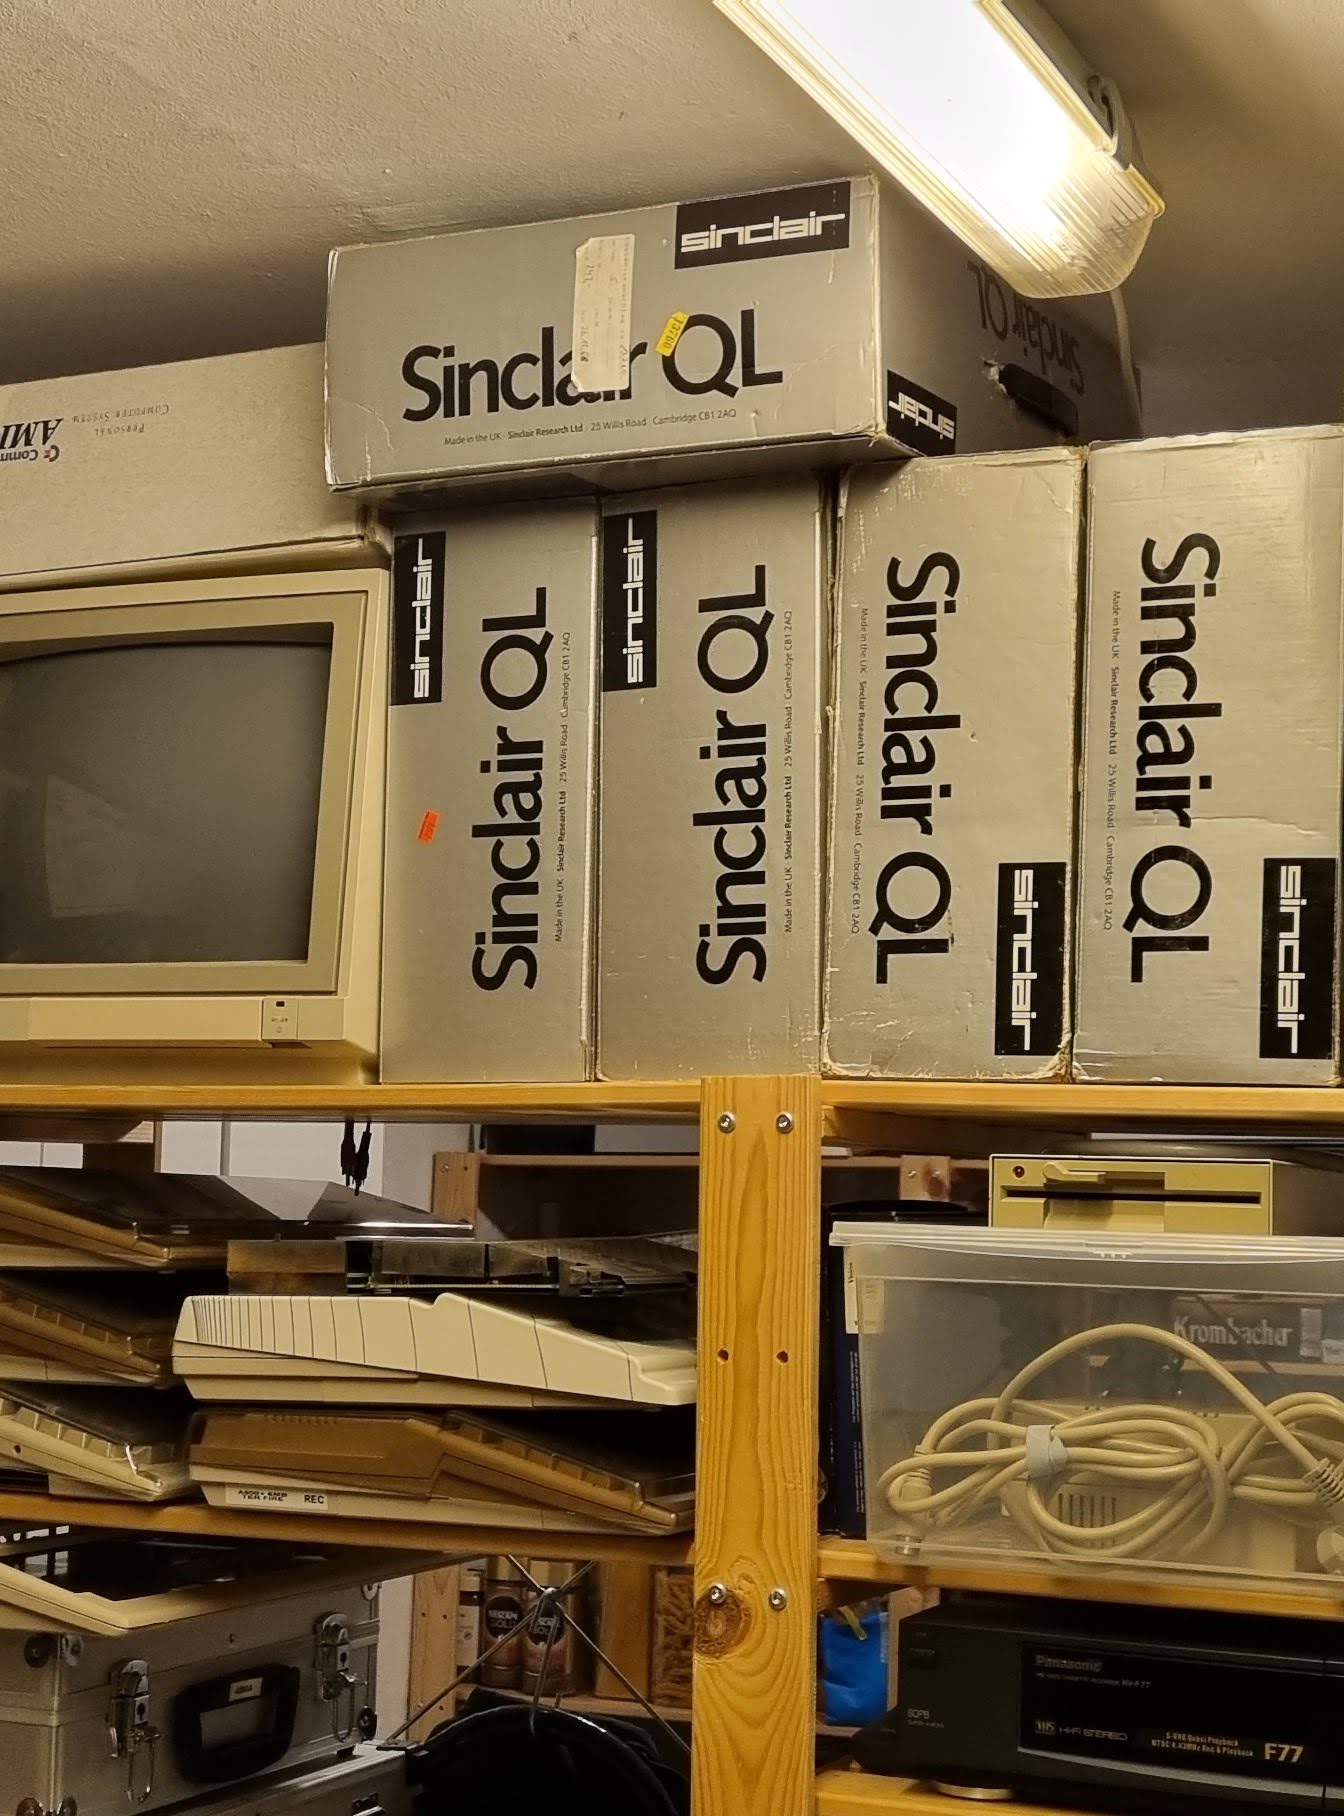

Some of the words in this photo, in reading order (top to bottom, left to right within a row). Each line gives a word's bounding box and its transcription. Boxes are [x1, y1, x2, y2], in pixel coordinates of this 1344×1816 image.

[680, 210, 845, 253] sinclair
[401, 325, 647, 423] Sinclar
[662, 308, 784, 399] QL
[889, 392, 955, 441] sinclair
[444, 436, 465, 446] Made
[466, 435, 475, 444] in
[475, 434, 488, 443] the
[488, 432, 502, 441] UK
[508, 428, 534, 440] Sinclair
[536, 425, 568, 437] Research
[569, 423, 584, 434] Ltd
[591, 422, 602, 432] 25
[625, 418, 647, 429] Road
[652, 412, 697, 426] Cambridge
[623, 517, 645, 685] sinclair
[1111, 590, 1121, 614] Made
[410, 537, 433, 699] sinclair
[697, 564, 775, 694] QL
[859, 607, 869, 630] Made
[1111, 617, 1121, 626] in
[859, 633, 869, 642] in
[1111, 628, 1121, 643] the
[480, 586, 554, 711] QL
[859, 644, 869, 659] the
[1111, 644, 1120, 660] UK
[783, 653, 796, 700] Cambridge
[859, 660, 867, 674] UK
[1109, 666, 1119, 696] Sinclair
[1134, 532, 1223, 829] Sinclair
[560, 672, 572, 718] Cambridge
[857, 681, 867, 707] Sinclair
[879, 551, 961, 836] Sinclair
[783, 706, 793, 729] Road
[856, 708, 866, 748] Research
[1108, 699, 1119, 740] Research
[559, 724, 569, 746] Road
[856, 750, 866, 766] Ltd
[1108, 742, 1118, 755] Ltd
[783, 755, 793, 768] 25
[1108, 764, 1117, 776] 25
[559, 771, 567, 783] 25
[783, 776, 793, 791] Ltd
[855, 774, 864, 786] 25
[558, 790, 567, 807] Ltd
[783, 792, 793, 829] Research
[557, 807, 567, 844] Research
[854, 812, 864, 836] Road
[1107, 804, 1117, 828] Road
[693, 709, 768, 984] Sinclair
[783, 830, 793, 860] Sinclair
[471, 725, 544, 991] Sinclair
[556, 847, 566, 872] Sinclair
[850, 842, 863, 891] Cambridge
[1103, 835, 1116, 886] Cambridge
[556, 879, 565, 893] UK
[783, 867, 793, 881] UK
[555, 894, 564, 908] the
[783, 882, 793, 898] the
[555, 909, 564, 918] in
[783, 899, 793, 910] in
[1122, 844, 1213, 984] QL
[783, 911, 793, 933] Made
[868, 851, 953, 985] QL
[553, 919, 563, 942] Made
[1010, 868, 1039, 1052] sinclair
[1276, 864, 1307, 1054] sinclair
[304, 1494, 325, 1504] REC
[1036, 1655, 1102, 1672] Panasonic
[1083, 1729, 1128, 1742] STEREO
[1264, 1742, 1304, 1763] F77
